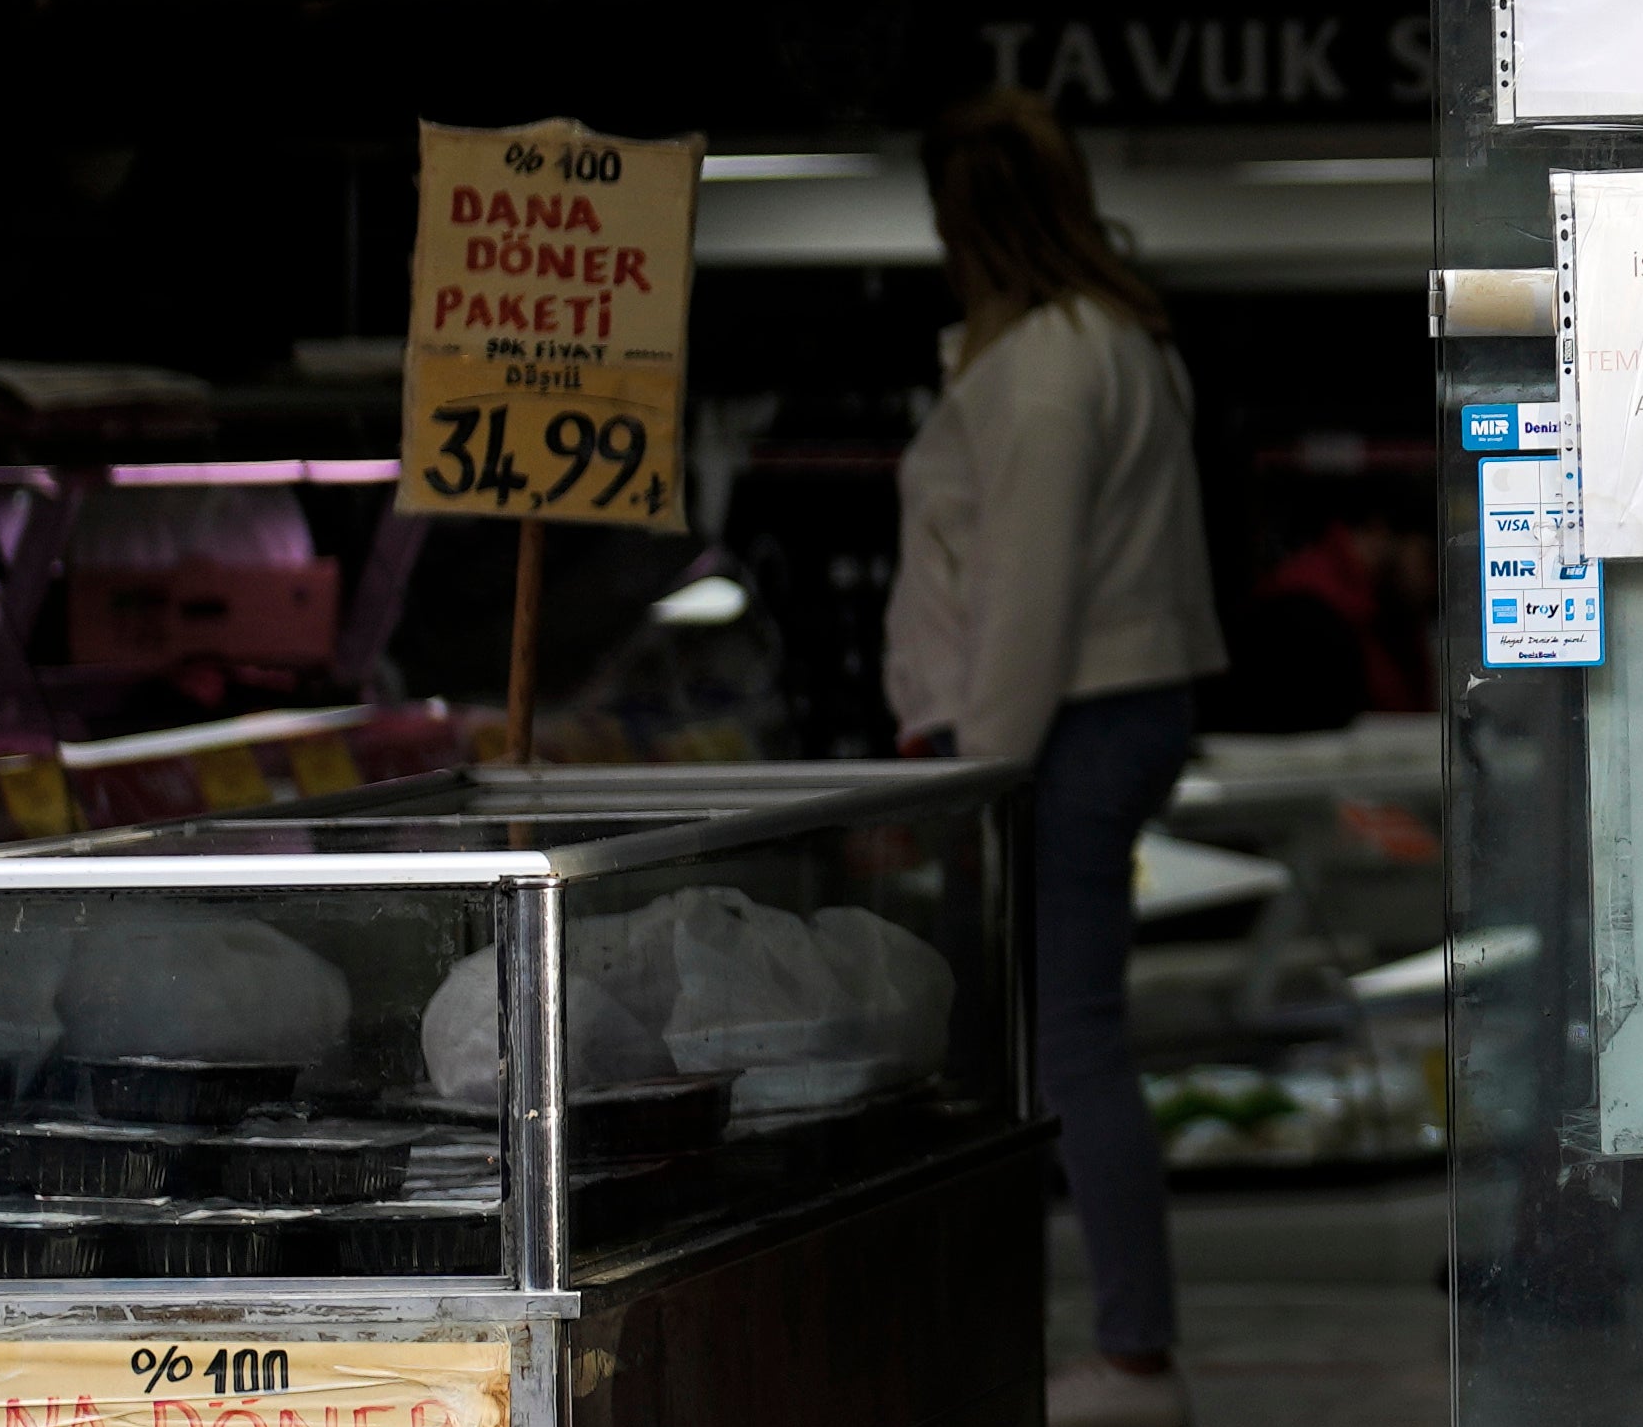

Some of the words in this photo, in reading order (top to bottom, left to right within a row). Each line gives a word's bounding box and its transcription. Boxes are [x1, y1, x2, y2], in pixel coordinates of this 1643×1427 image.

[974, 17, 1350, 108] TAVUK
[558, 146, 622, 184] 100
[451, 184, 602, 234] DANA
[466, 230, 651, 294] DÖNER
[435, 286, 612, 339] PAKETİ
[535, 338, 608, 362] FİYAT
[1471, 420, 1510, 435] MIR
[1524, 421, 1561, 433] Deniz
[1496, 519, 1530, 531] VISA
[1490, 560, 1536, 577] MIR
[1525, 603, 1559, 618] troy
[130, 1345, 193, 1394] %
[204, 1348, 289, 1394] 100
